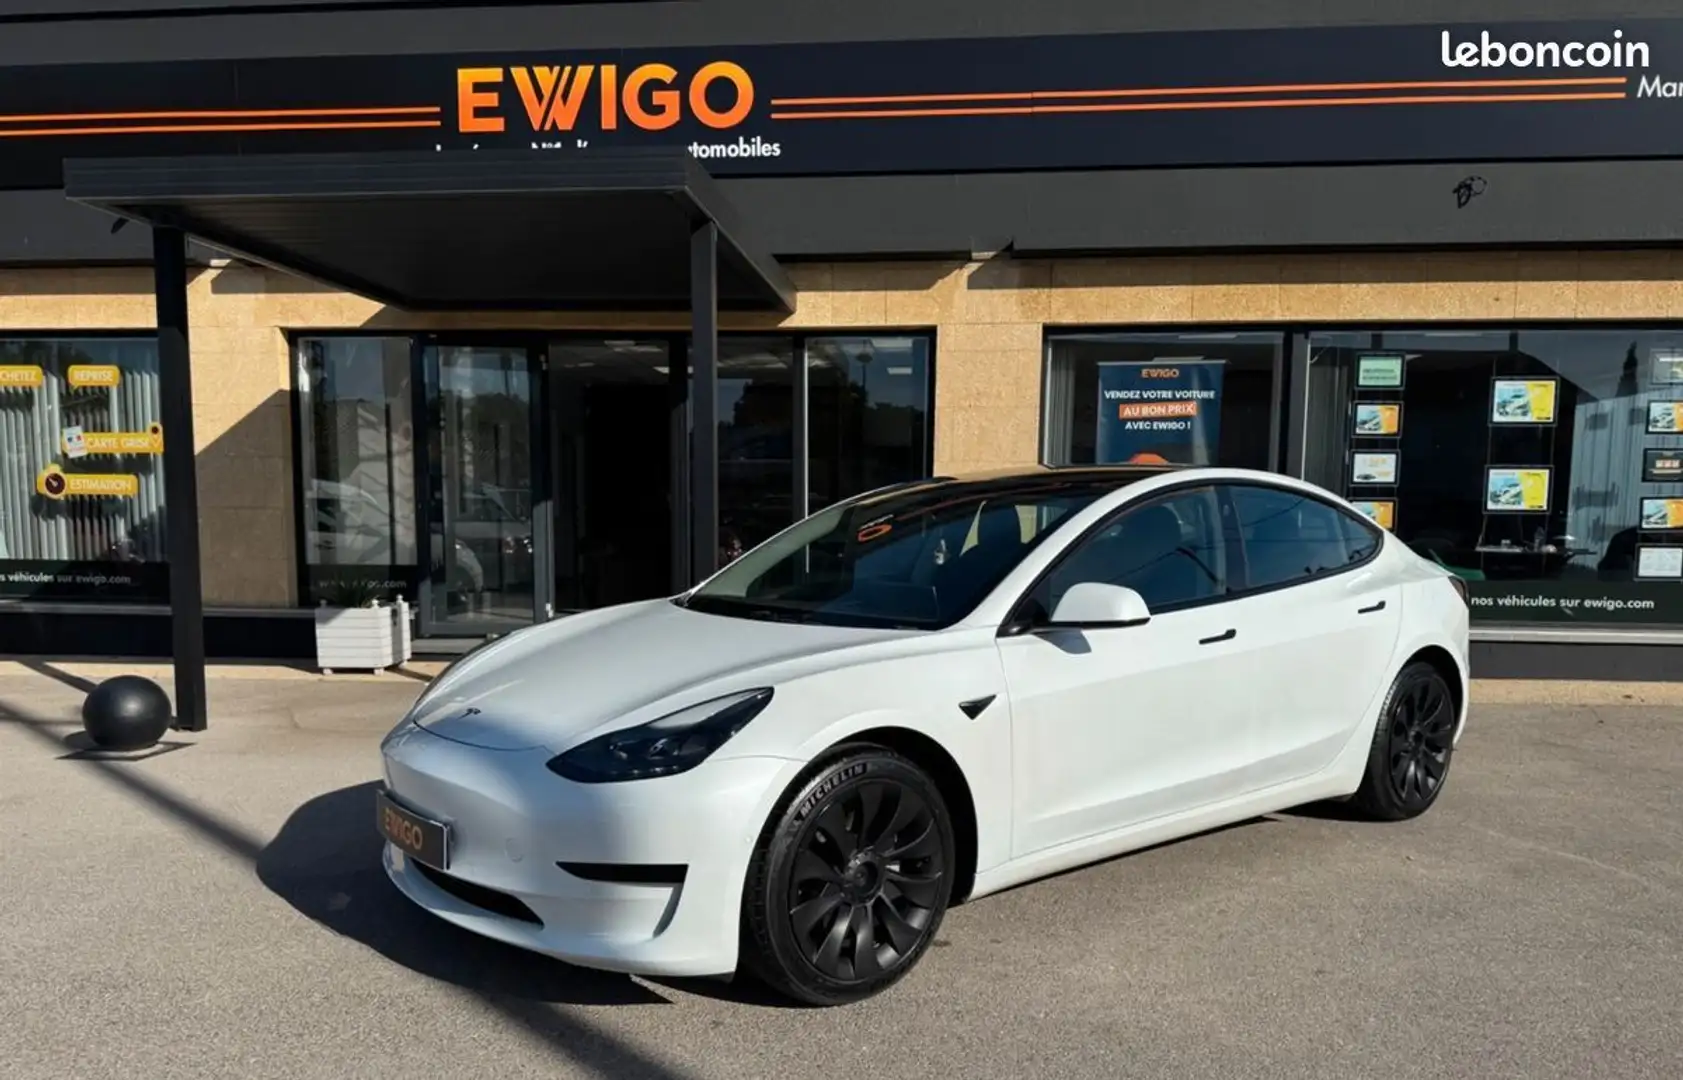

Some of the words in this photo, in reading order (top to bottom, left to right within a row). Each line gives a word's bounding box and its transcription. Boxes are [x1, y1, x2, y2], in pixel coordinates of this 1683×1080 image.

[457, 61, 754, 133] EWIGO
[1142, 369, 1179, 378] EWIGO
[1104, 390, 1140, 399] VENDEZ
[1142, 390, 1173, 399] VOTRE
[1175, 390, 1215, 399] VOITURE
[1123, 407, 1139, 417] AU
[1141, 405, 1166, 415] BON
[1168, 403, 1194, 414] PRIX
[1125, 421, 1151, 430] AVEC
[1153, 421, 1184, 430] EWIGO
[70, 479, 132, 491] ESTIMATION
[1471, 596, 1494, 607] nos
[1497, 595, 1556, 607] véhicules
[1560, 598, 1580, 608] sur
[1584, 597, 1655, 611] ewigo.com
[800, 763, 864, 819] MICHELIN
